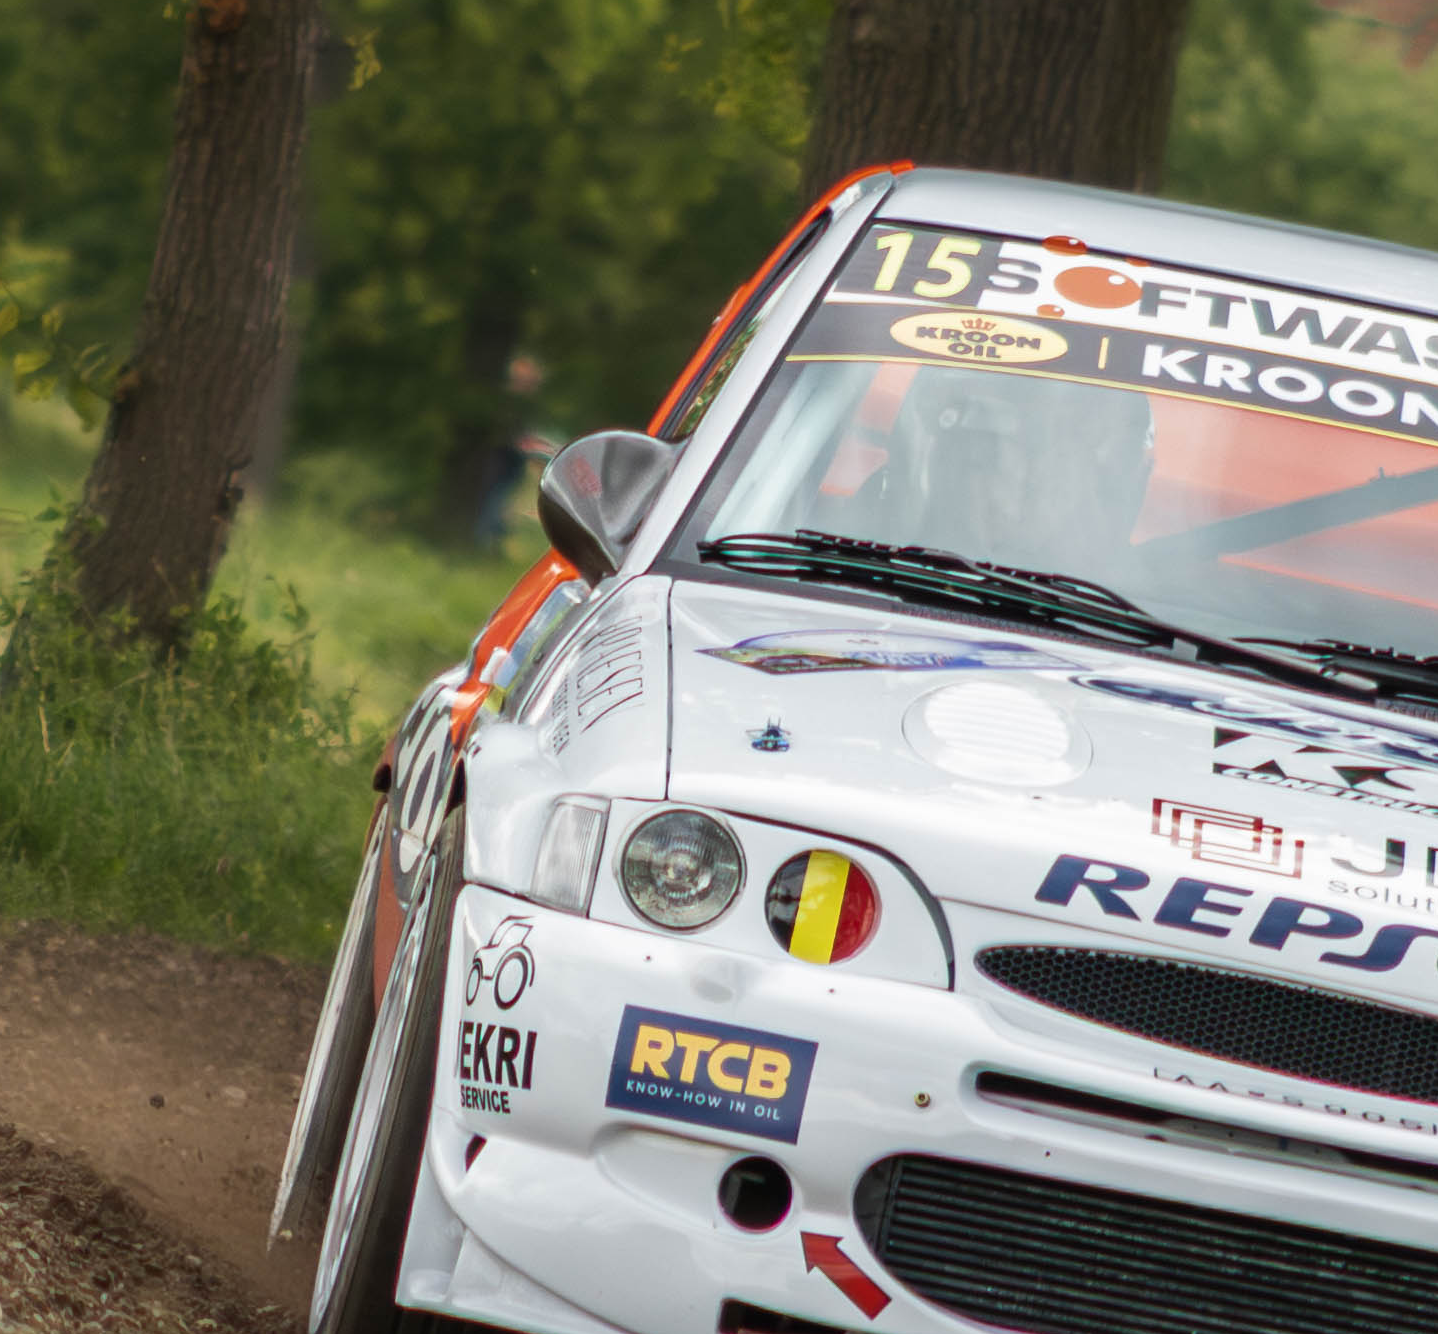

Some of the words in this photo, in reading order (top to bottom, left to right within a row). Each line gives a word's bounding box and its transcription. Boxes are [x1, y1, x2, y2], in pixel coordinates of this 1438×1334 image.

[876, 231, 982, 299] 15
[916, 327, 1042, 350] KROON
[948, 342, 1002, 359] OIL
[455, 1019, 538, 1090] EKRI
[630, 1024, 792, 1100] RTCB
[461, 1083, 511, 1114] SERVICE
[626, 1079, 722, 1108] KNOW-HOW
[729, 1100, 746, 1113] IN
[754, 1105, 780, 1121] OIL
